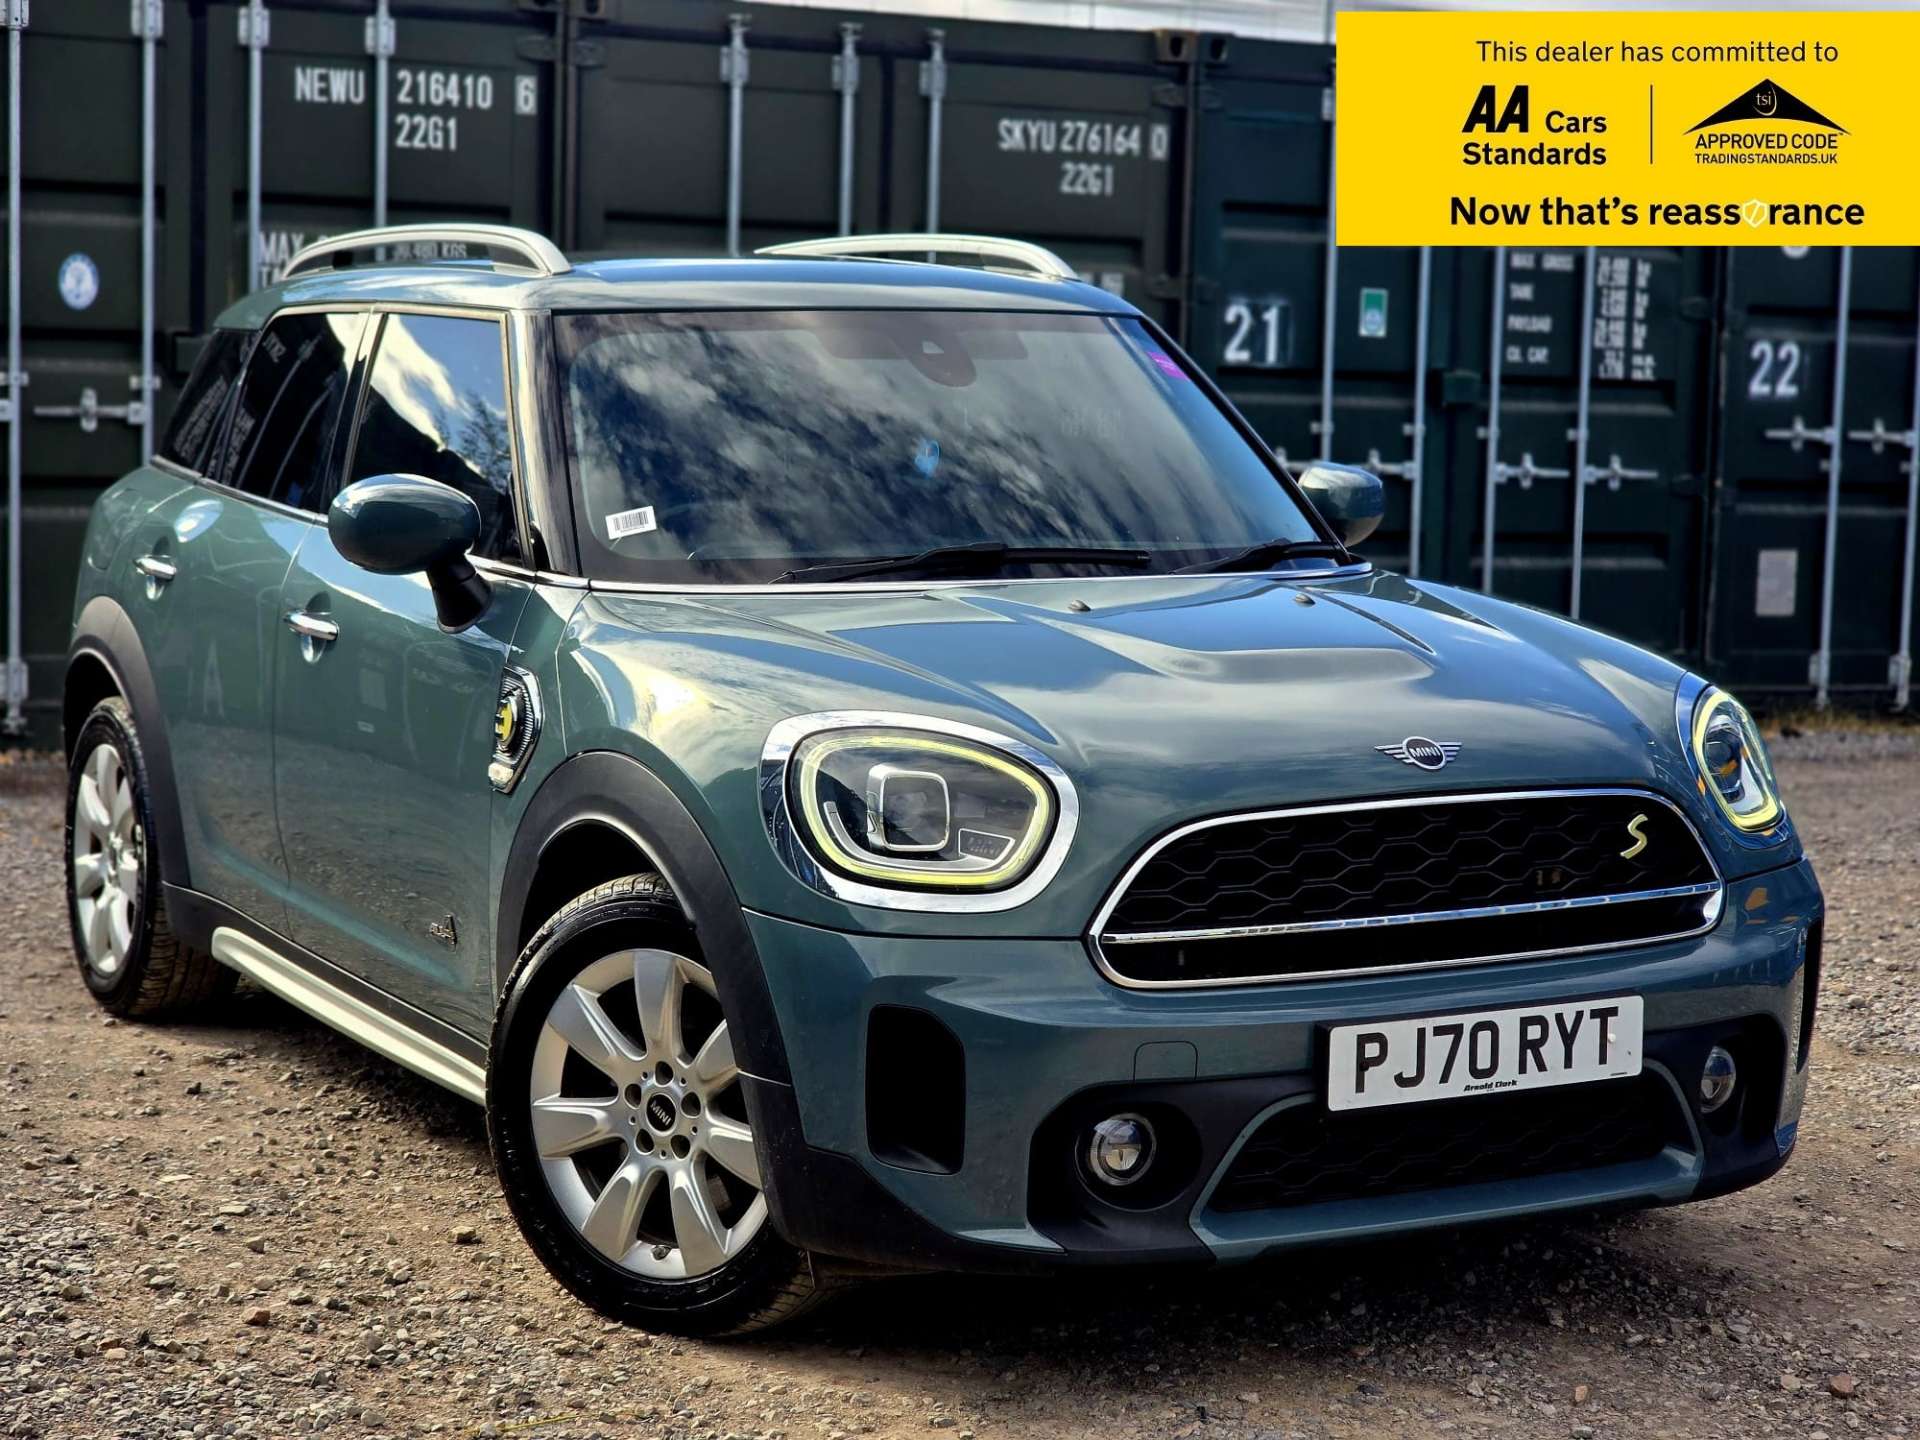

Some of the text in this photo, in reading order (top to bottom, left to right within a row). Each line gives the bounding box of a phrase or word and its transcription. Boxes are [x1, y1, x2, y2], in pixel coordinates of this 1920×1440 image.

[295, 67, 537, 115] NEWU 216410 6
[395, 114, 457, 151] 22G1
[998, 119, 1057, 153] SKYU
[1060, 121, 1140, 156] 276164
[1060, 162, 1114, 195] 22G1
[1223, 303, 1280, 366] 21
[1749, 339, 1801, 398] 22
[1408, 745, 1441, 759] MINI
[1620, 813, 1649, 860] S
[1354, 1005, 1620, 1094] PJ70 RYT
[649, 1099, 672, 1127] MINI
